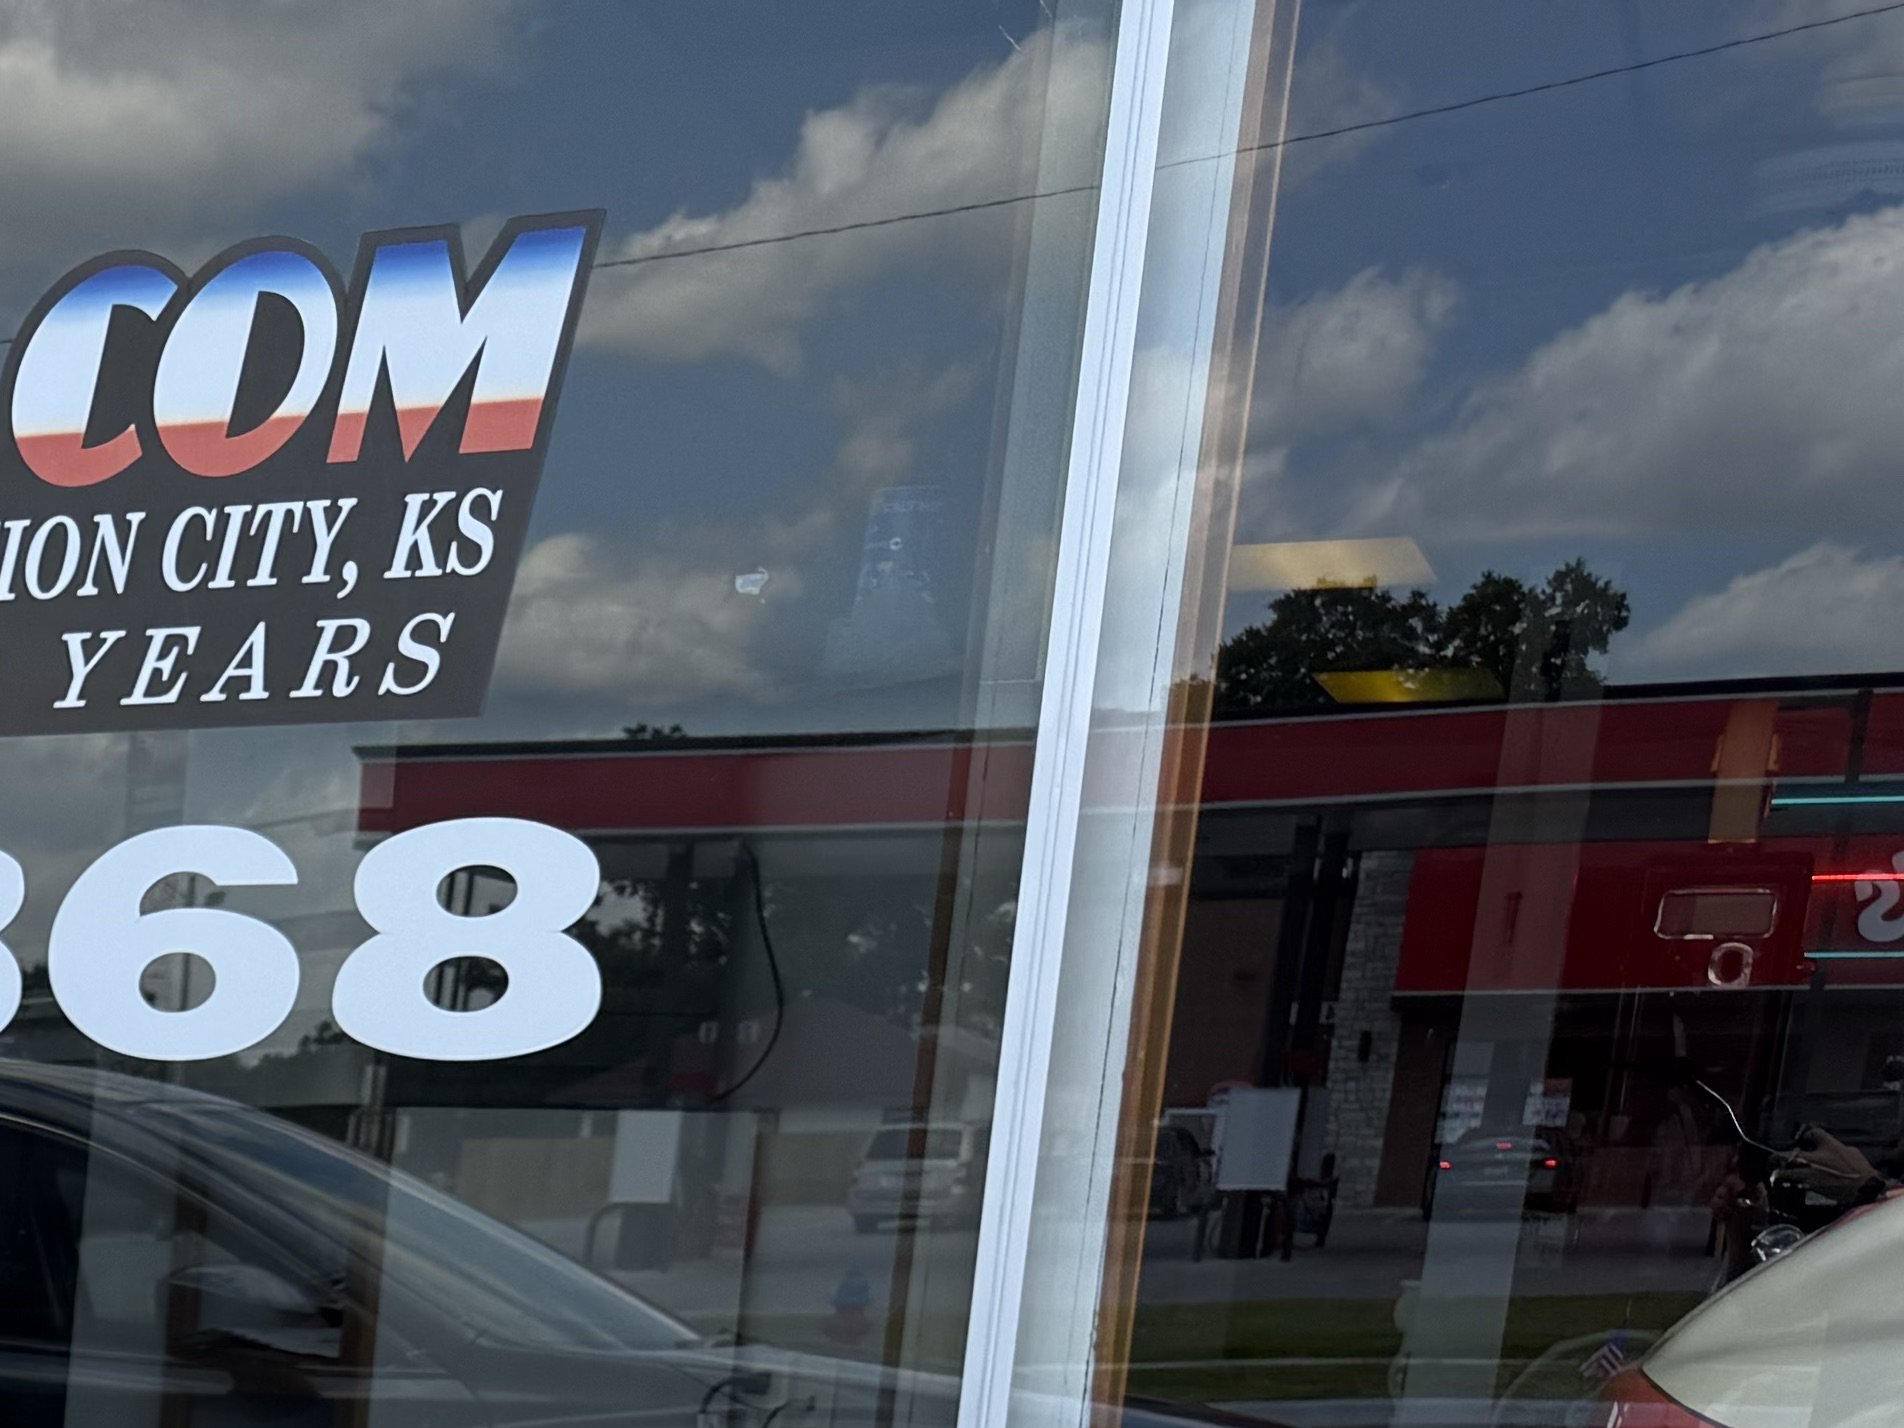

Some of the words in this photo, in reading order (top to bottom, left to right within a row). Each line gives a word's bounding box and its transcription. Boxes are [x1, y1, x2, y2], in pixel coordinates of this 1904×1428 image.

[161, 496, 359, 600] CITY,
[382, 486, 505, 580] KS
[52, 611, 457, 710] YEARS
